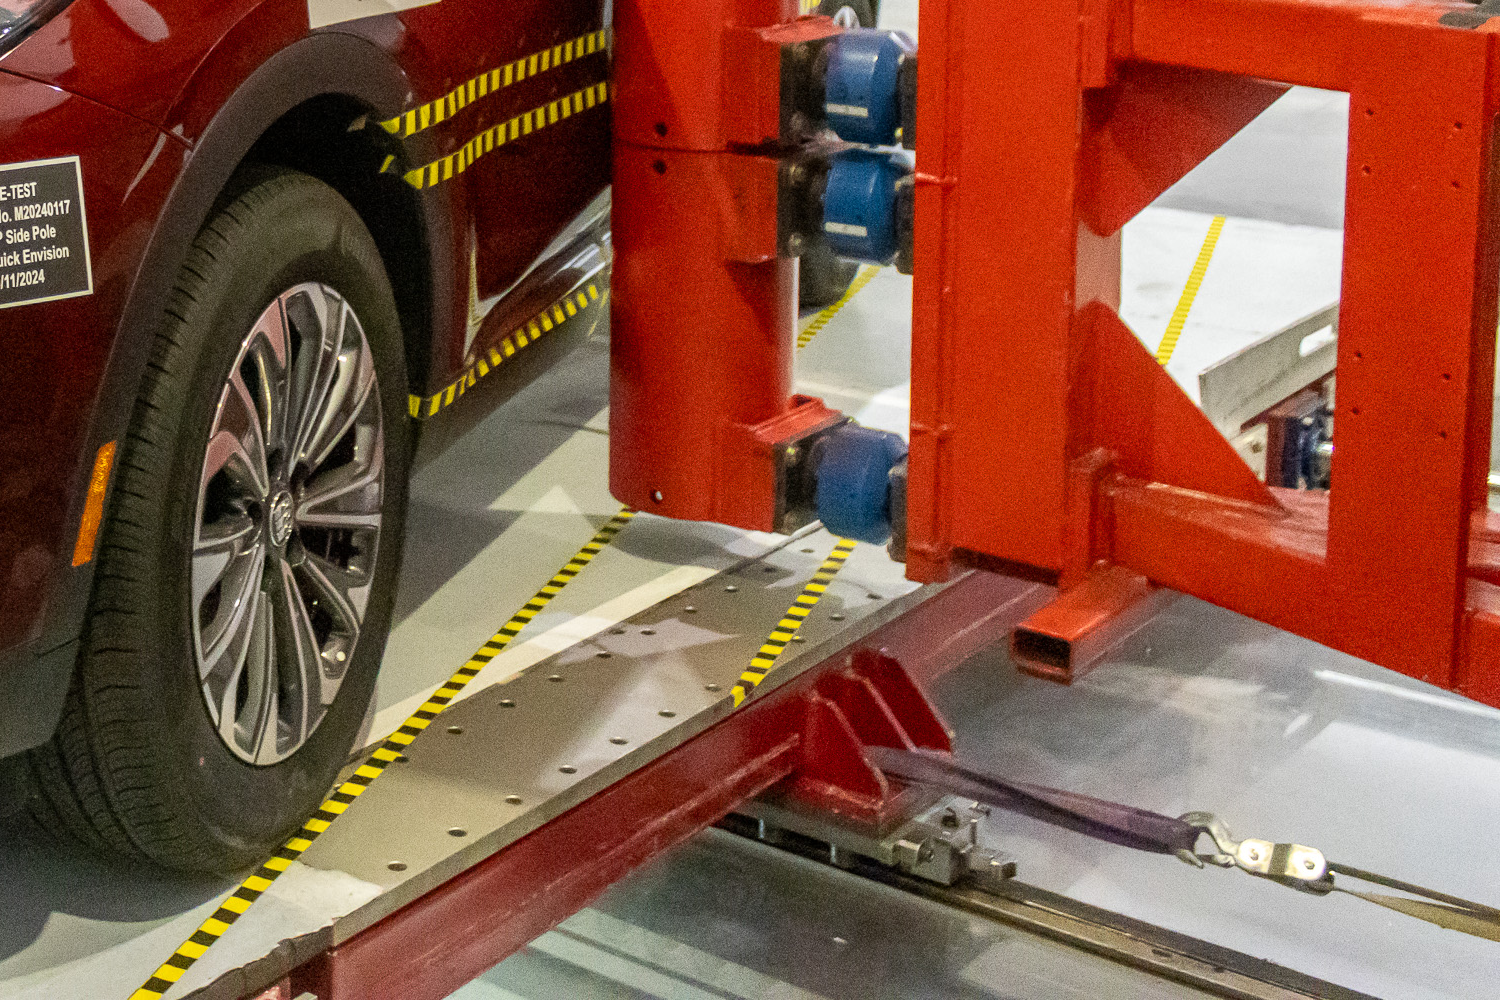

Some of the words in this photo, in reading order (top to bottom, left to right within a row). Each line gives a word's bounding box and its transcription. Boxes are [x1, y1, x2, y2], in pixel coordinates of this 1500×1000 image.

[14, 199, 71, 221] M20240117
[5, 228, 30, 245] Side
[32, 224, 57, 241] Pole
[22, 245, 70, 264] Envision
